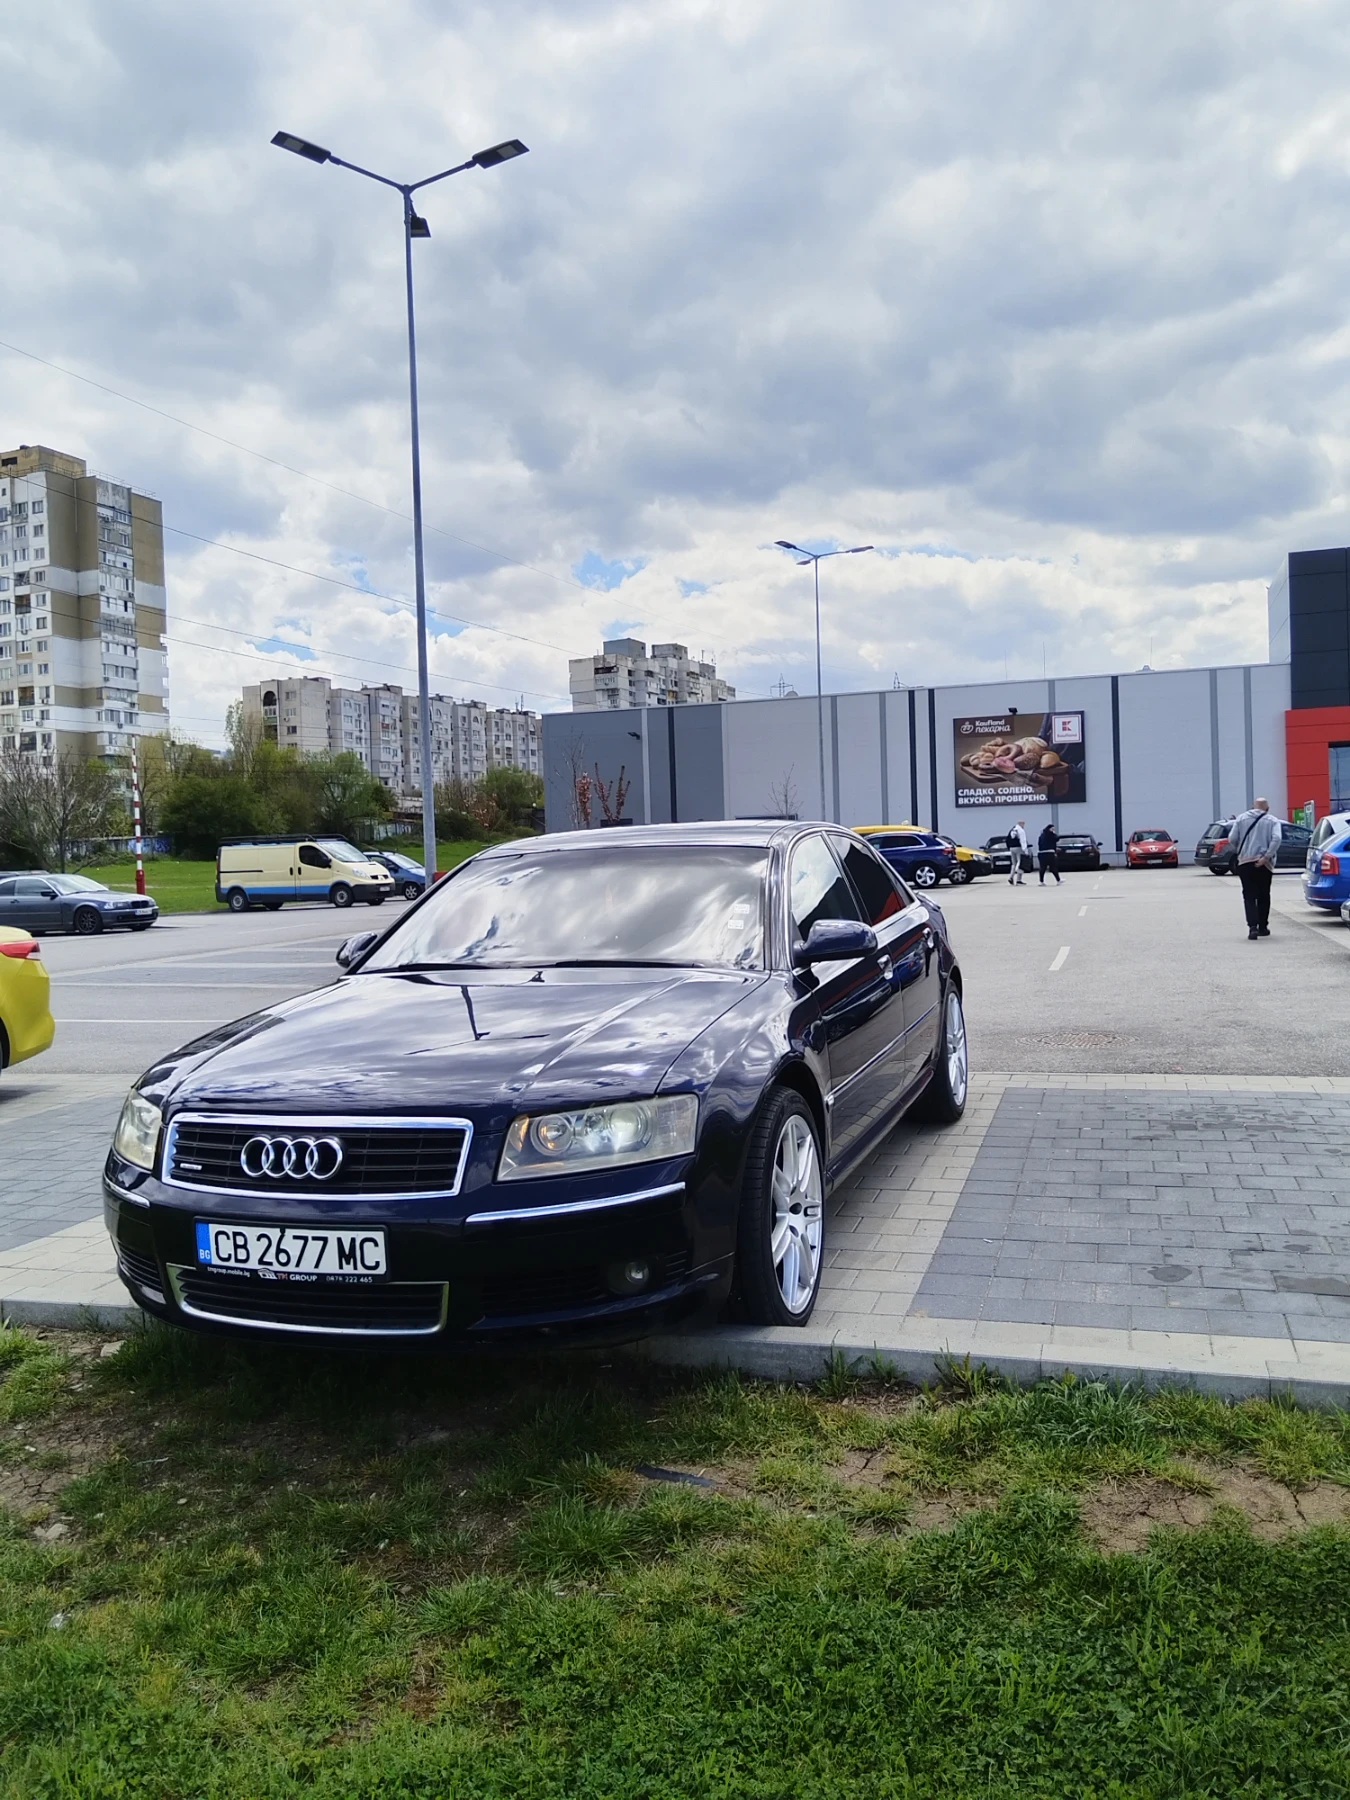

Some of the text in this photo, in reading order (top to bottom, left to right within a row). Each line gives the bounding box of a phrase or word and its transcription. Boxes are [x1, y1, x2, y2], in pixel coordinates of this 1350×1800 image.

[975, 719, 1005, 727] Kaufland
[975, 725, 1011, 733] пекарна
[958, 786, 1034, 797] СЛАДКО. СОЛЕНО.
[958, 793, 1048, 805] ВКУСНО. ПРОВЕРЕНО.
[200, 1249, 211, 1260] BG
[214, 1230, 380, 1271] CB 2677 MC
[289, 1274, 318, 1282] GROUP
